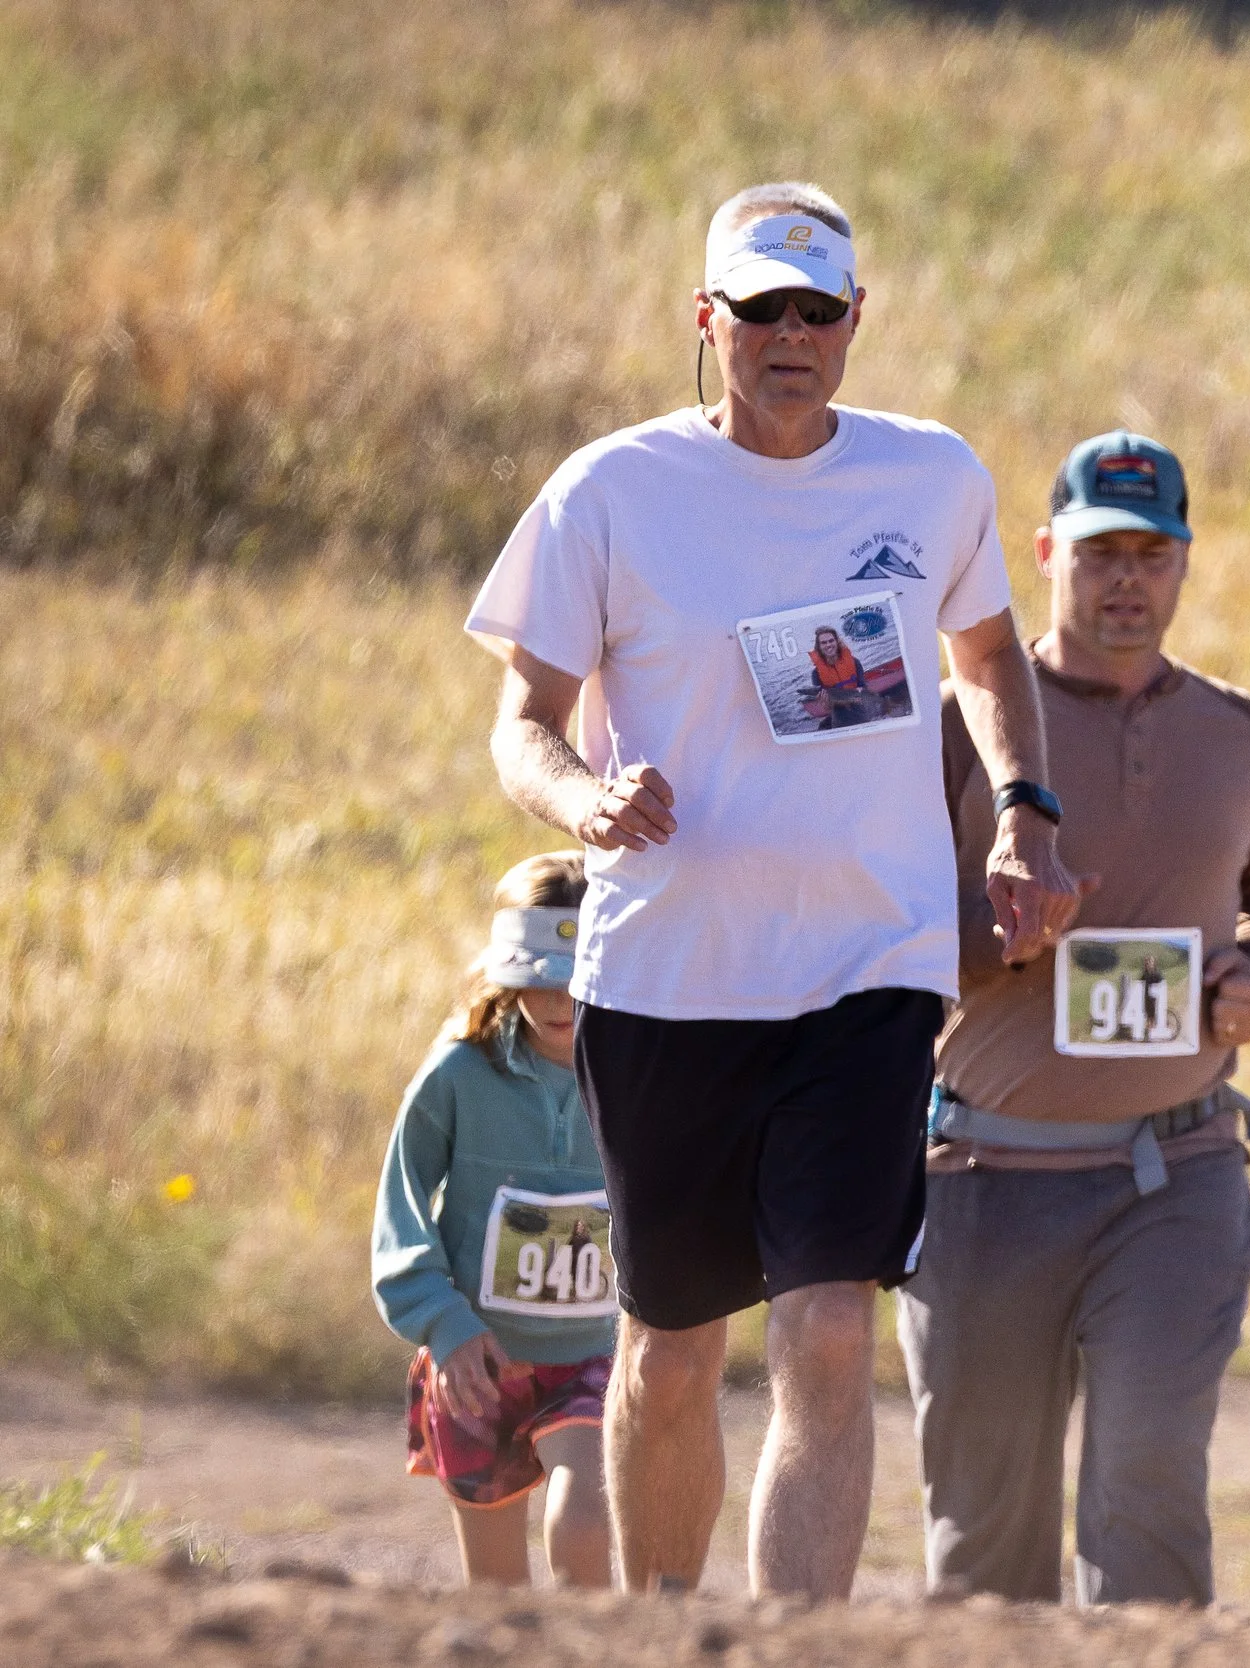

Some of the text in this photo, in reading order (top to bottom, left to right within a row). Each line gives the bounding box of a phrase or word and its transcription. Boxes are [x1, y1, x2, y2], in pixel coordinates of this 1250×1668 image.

[749, 627, 798, 663] 746
[1089, 979, 1173, 1041] 941
[515, 1242, 601, 1301] 940
